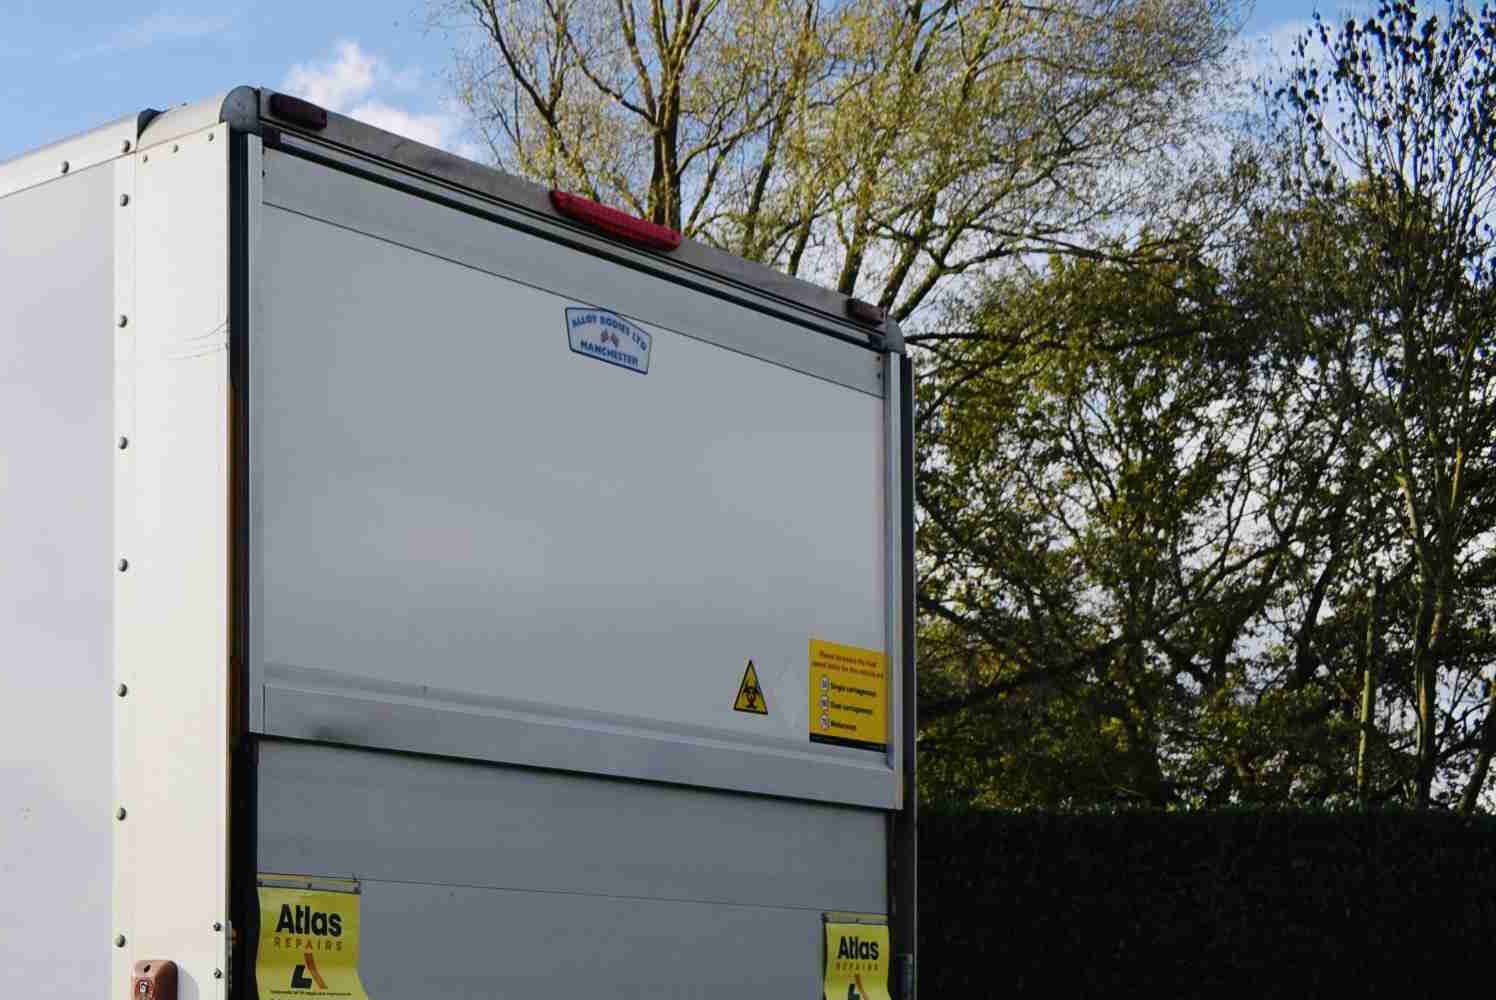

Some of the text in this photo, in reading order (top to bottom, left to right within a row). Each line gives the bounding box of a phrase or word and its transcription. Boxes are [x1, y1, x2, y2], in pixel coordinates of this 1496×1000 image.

[580, 339, 639, 368] MANCHESTER
[275, 903, 343, 938] Atlas
[273, 937, 344, 952] REPAIRS
[837, 935, 880, 961] Atlas
